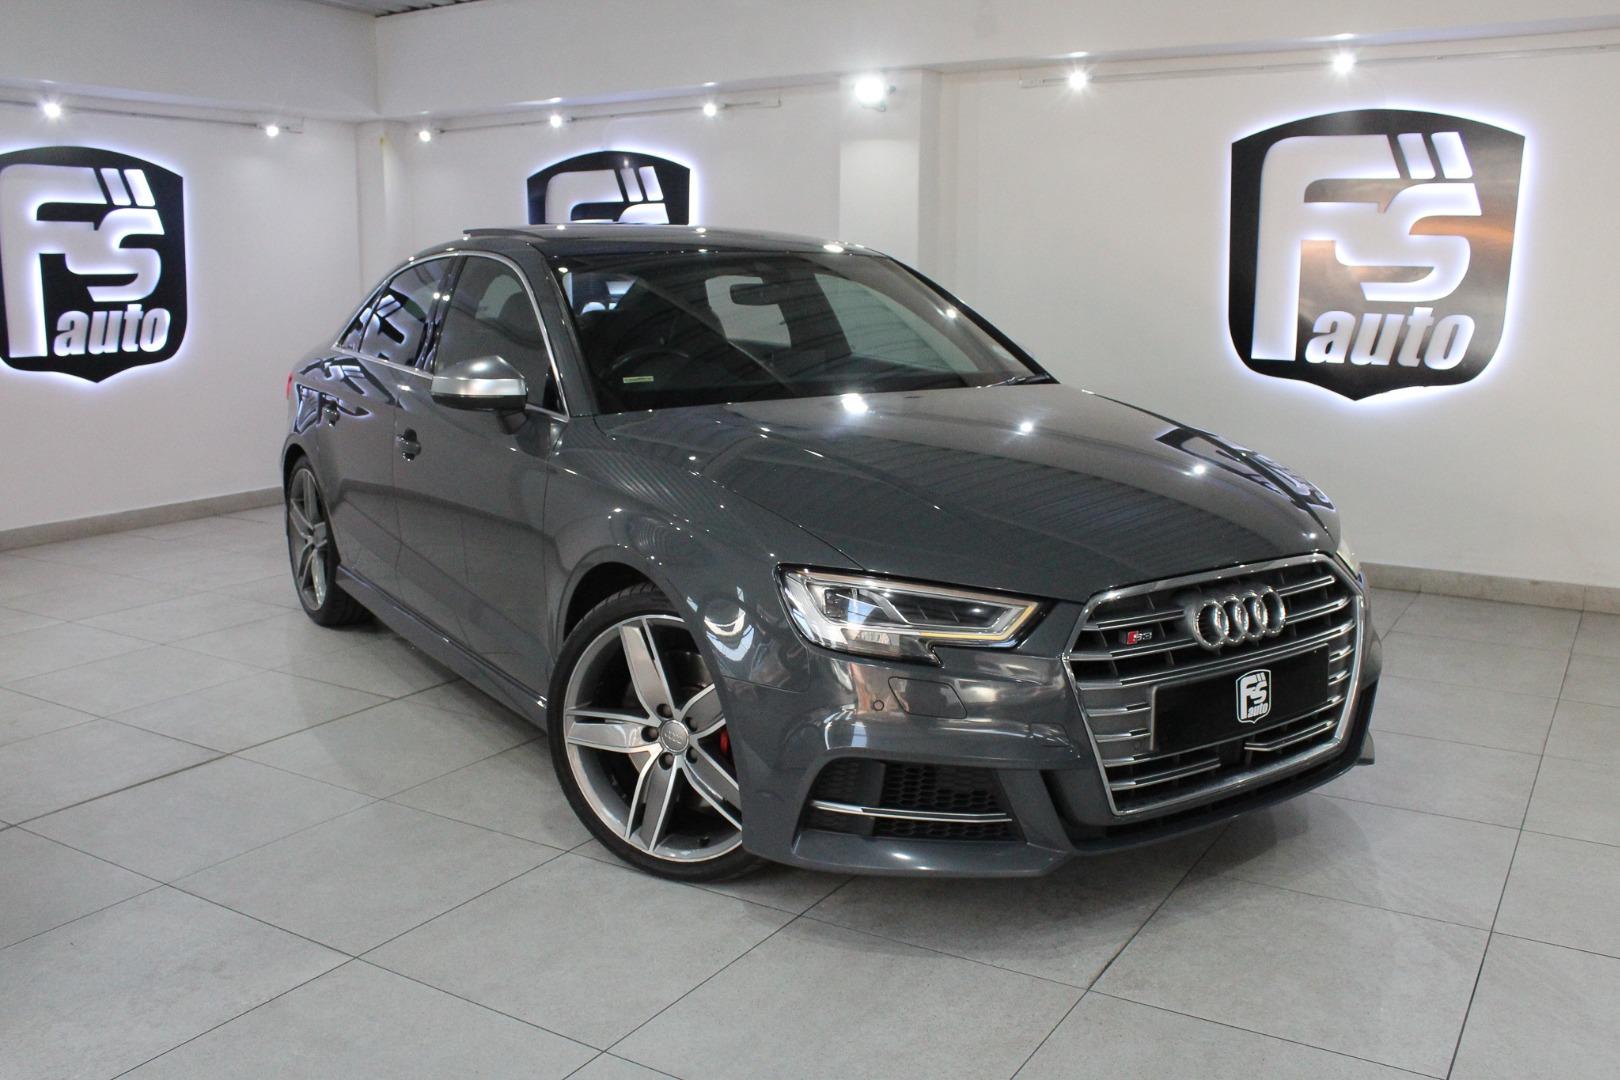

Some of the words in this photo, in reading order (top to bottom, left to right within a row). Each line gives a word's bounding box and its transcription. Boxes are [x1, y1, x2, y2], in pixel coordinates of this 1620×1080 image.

[1250, 131, 1482, 361] FS
[53, 303, 171, 356] auto
[1304, 306, 1475, 370] auto
